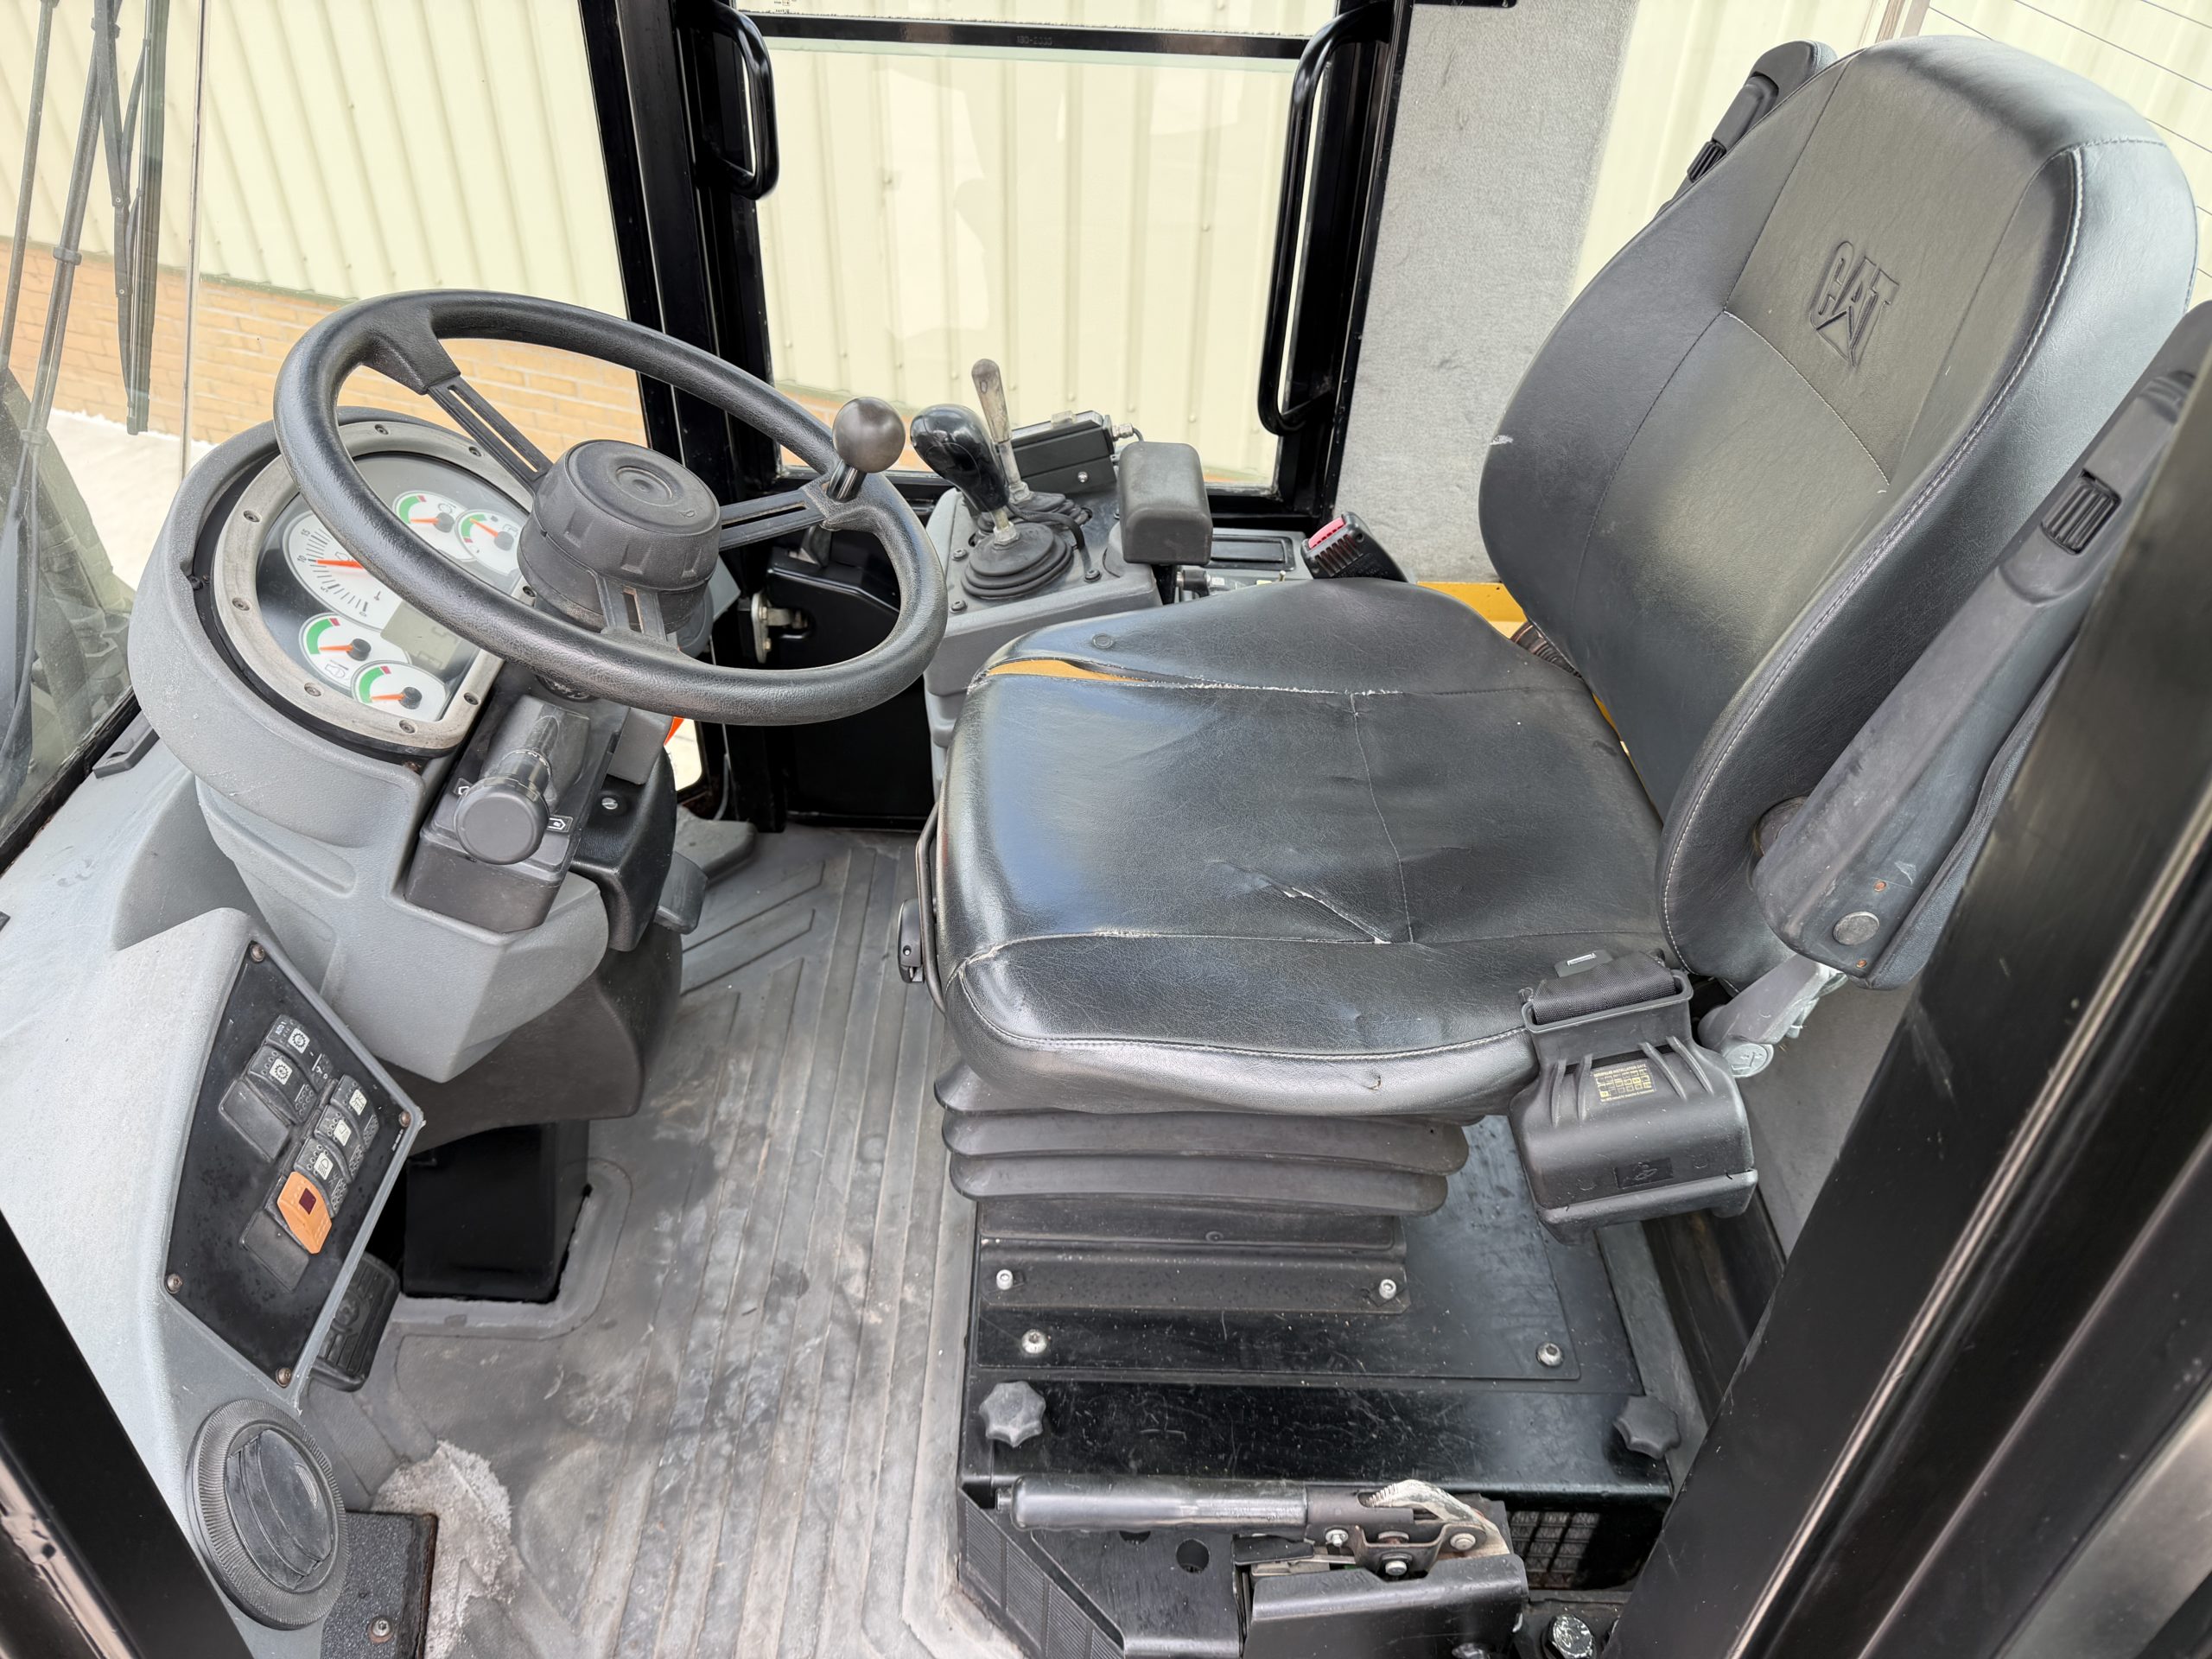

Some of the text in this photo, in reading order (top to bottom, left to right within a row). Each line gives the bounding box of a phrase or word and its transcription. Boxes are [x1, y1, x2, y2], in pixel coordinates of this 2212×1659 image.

[1808, 240, 1900, 369] CAT
[300, 528, 310, 537] 15
[296, 555, 308, 563] 10
